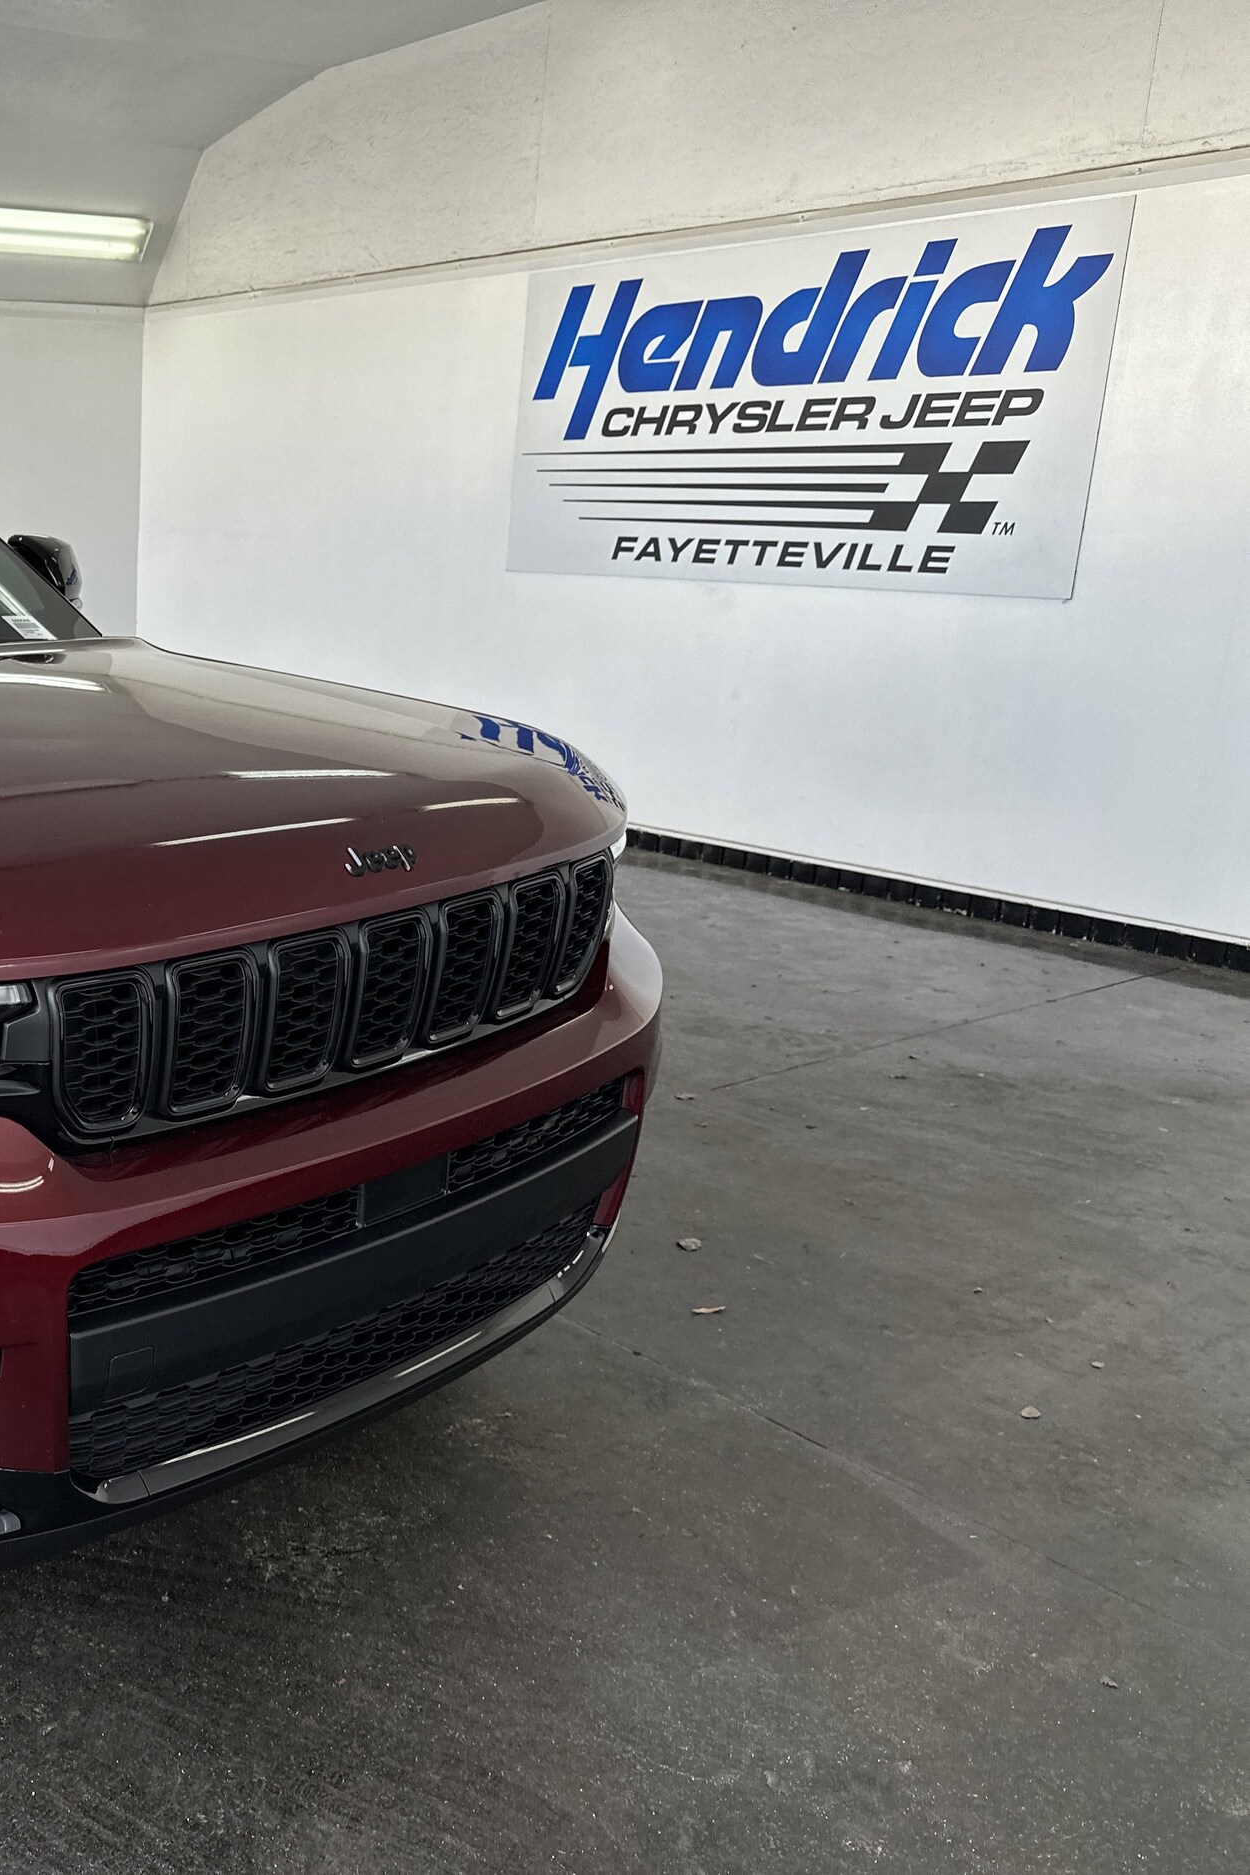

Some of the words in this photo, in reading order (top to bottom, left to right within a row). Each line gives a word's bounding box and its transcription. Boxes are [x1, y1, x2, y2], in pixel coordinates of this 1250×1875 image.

[533, 224, 1114, 441] Hendrick
[601, 396, 877, 438] CHRYSLER
[879, 388, 1045, 430] JEEP
[992, 521, 1016, 536] TM
[611, 536, 956, 574] FAYETTEVILLE
[344, 843, 418, 877] Jeep
